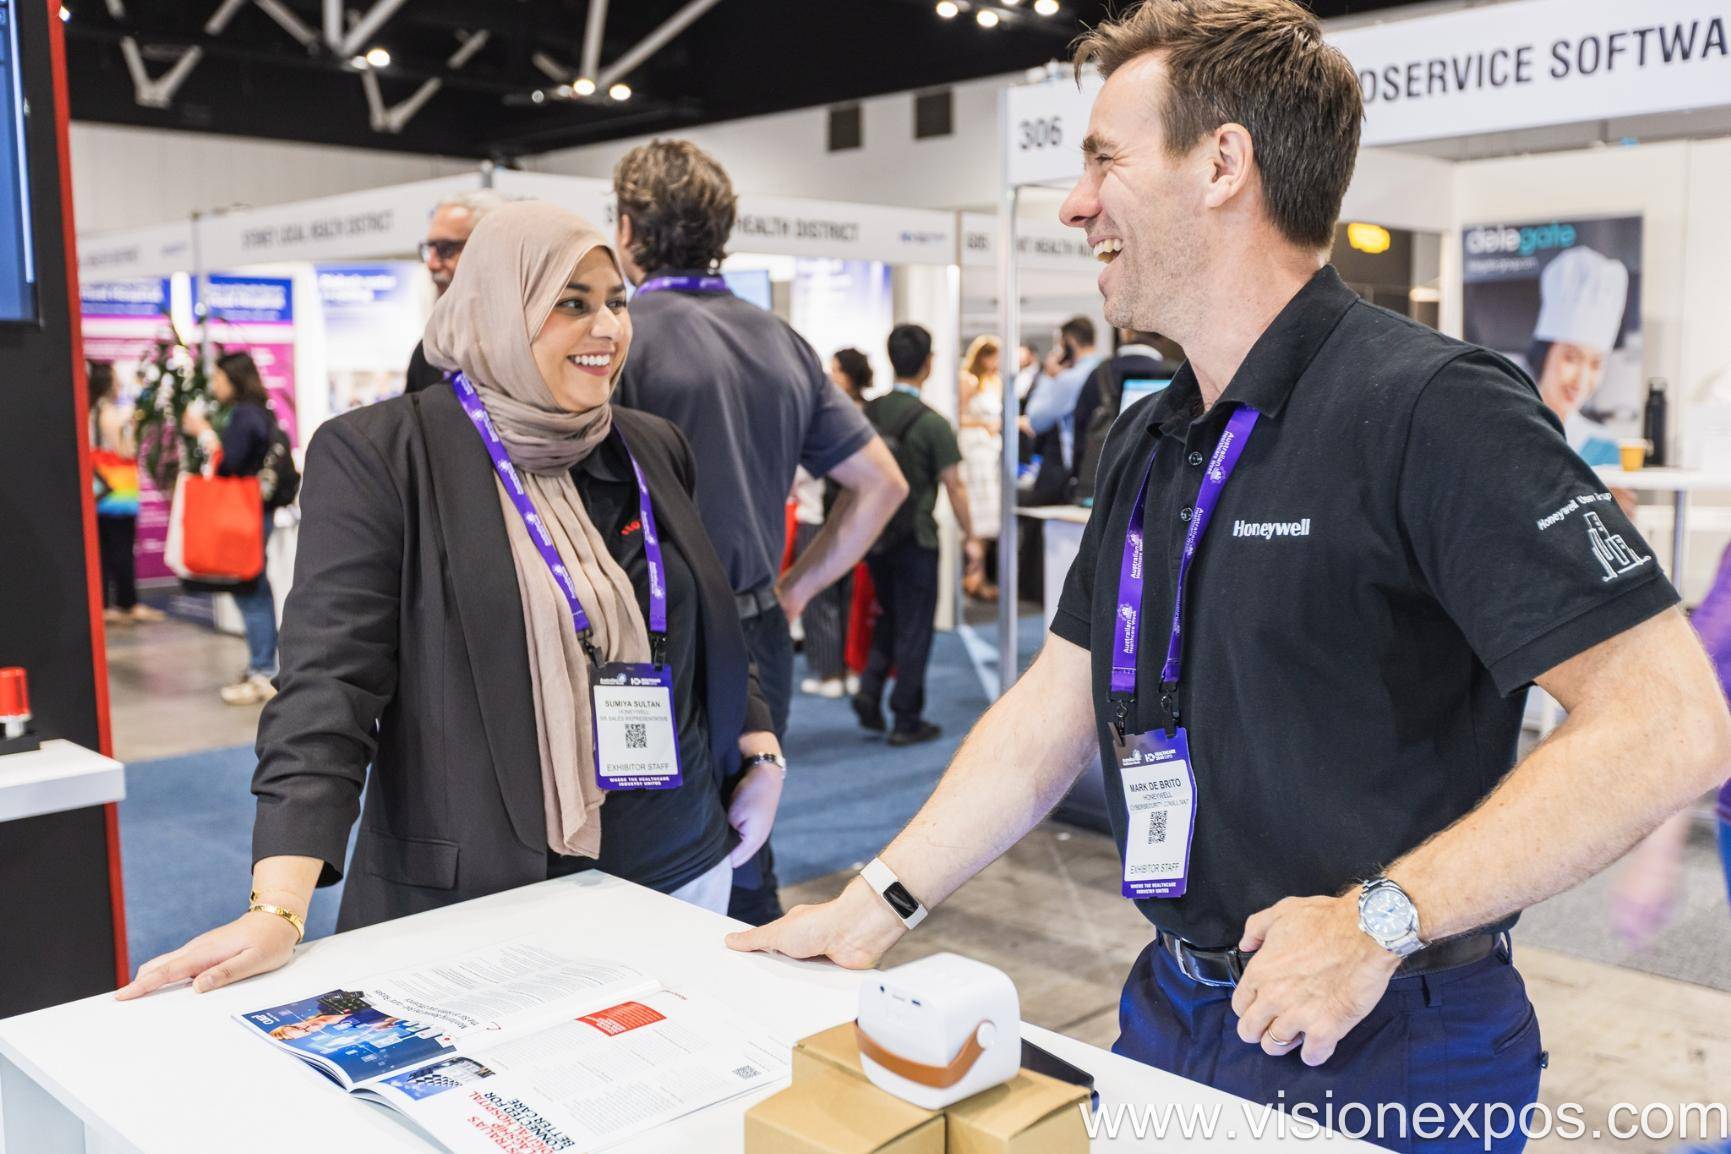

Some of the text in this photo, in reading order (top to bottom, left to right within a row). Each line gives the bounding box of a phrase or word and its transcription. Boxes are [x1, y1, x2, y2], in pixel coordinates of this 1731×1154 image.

[1549, 17, 1728, 80] SOFTWA
[1019, 116, 1063, 150] 306
[796, 219, 859, 241] DISTRICT
[1466, 220, 1576, 256] delegate
[1232, 518, 1311, 540] Honeywell
[1536, 499, 1579, 531] Honeywell
[1123, 619, 1131, 653] Australian
[605, 700, 661, 708] SUMIYA SULTAN
[607, 762, 670, 771] EXHIBITOR STAFF
[1129, 778, 1182, 793] MARK DE BRITO
[1129, 862, 1180, 874] EXHIBITOR STAFF
[468, 1090, 515, 1127] HOSPITAL
[484, 1092, 564, 1151] CONNECTED FOR
[508, 1098, 576, 1147] BETTER CARE
